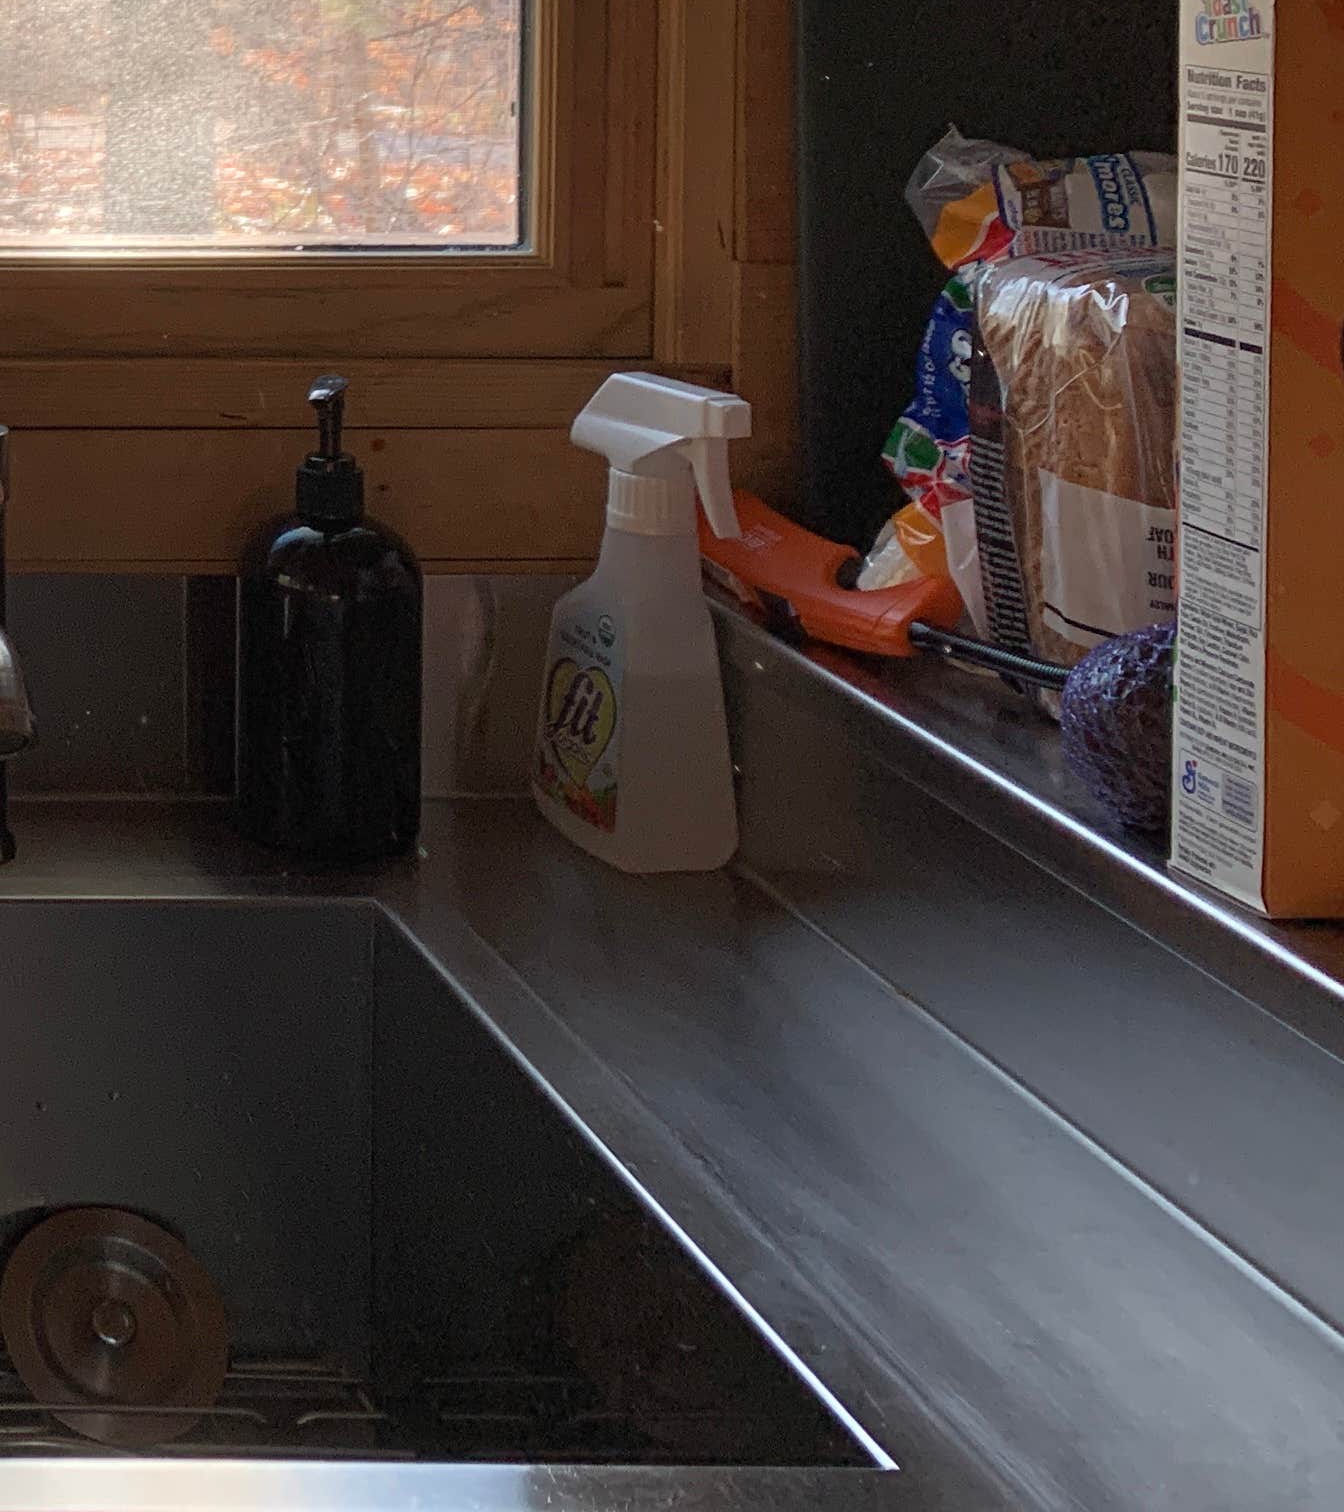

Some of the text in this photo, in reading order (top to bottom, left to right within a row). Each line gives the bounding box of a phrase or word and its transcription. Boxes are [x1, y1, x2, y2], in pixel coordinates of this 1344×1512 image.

[1196, 8, 1261, 45] Crunch
[1187, 68, 1266, 92] Nutrition Facts
[1186, 152, 1266, 178] Calories 170 220
[1120, 167, 1142, 206] CLASSIC
